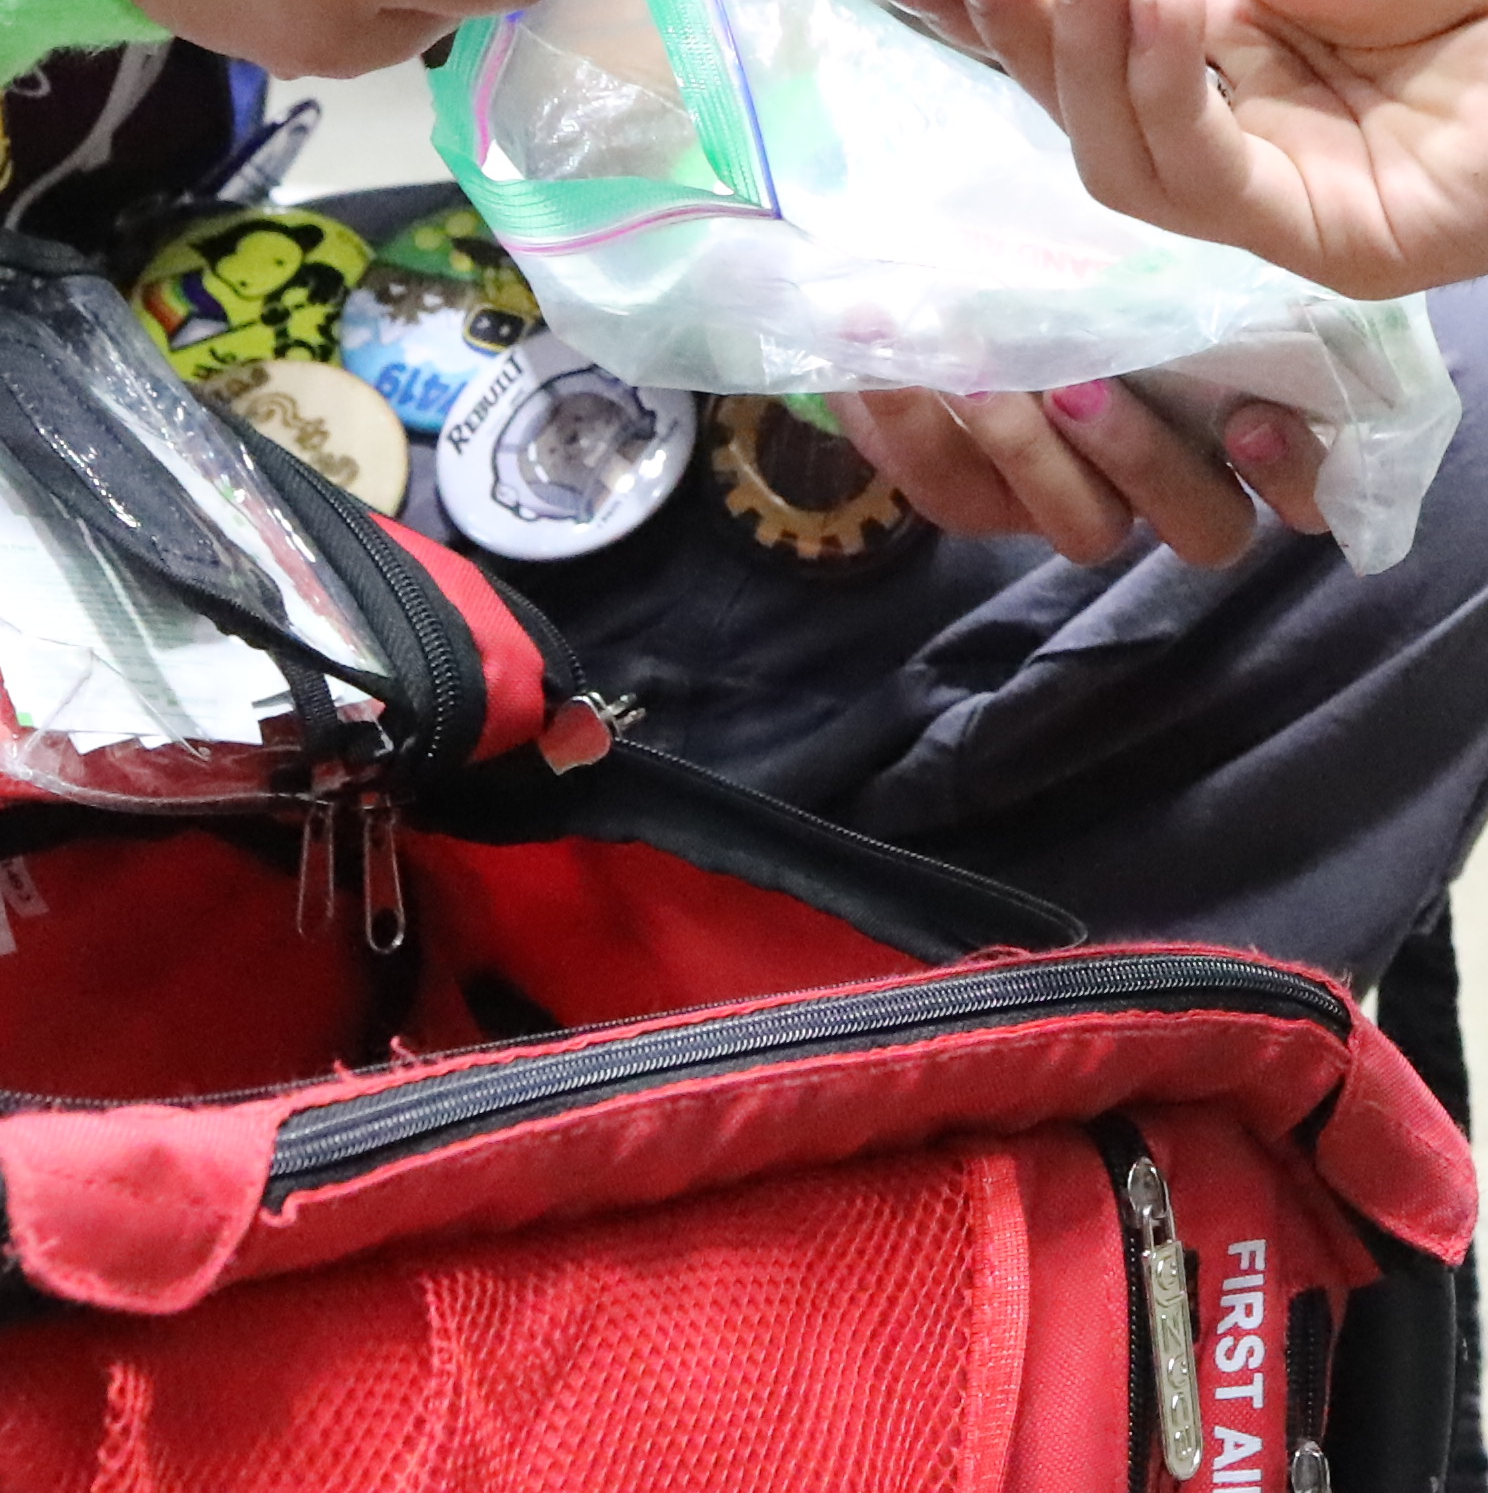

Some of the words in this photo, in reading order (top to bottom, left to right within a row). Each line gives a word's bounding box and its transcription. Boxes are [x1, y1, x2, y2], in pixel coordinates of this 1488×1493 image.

[445, 355, 525, 455] REBUILT
[1213, 1238, 1268, 1410] FIRST
[1212, 1425, 1264, 1493] AI
